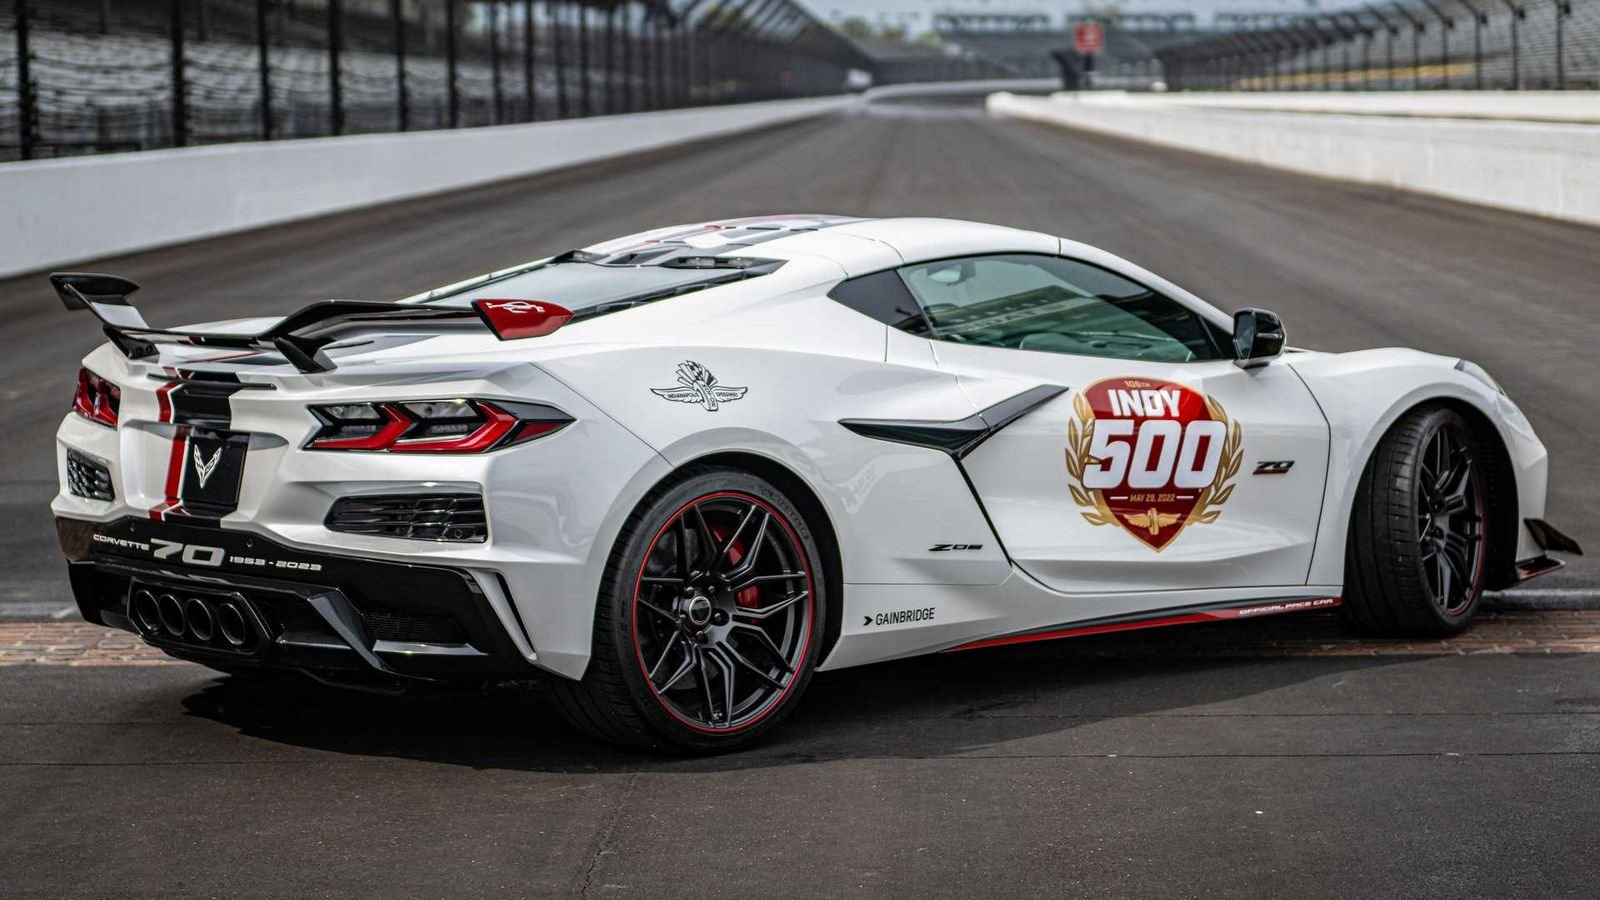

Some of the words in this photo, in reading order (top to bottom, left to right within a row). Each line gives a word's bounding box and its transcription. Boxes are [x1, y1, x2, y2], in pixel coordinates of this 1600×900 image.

[1108, 389, 1181, 417] INDY
[1082, 419, 1227, 489] 500
[1130, 493, 1145, 502] MAY
[1157, 493, 1176, 502] 2022
[93, 534, 149, 551] CORVETTE
[150, 537, 226, 567] 70
[230, 556, 266, 566] 1953
[275, 560, 322, 571] 2023
[876, 607, 936, 626] GAINBRIDGE
[1240, 605, 1284, 615] OFFICIAL
[1285, 601, 1312, 609] PACE
[1313, 598, 1334, 606] CAR
